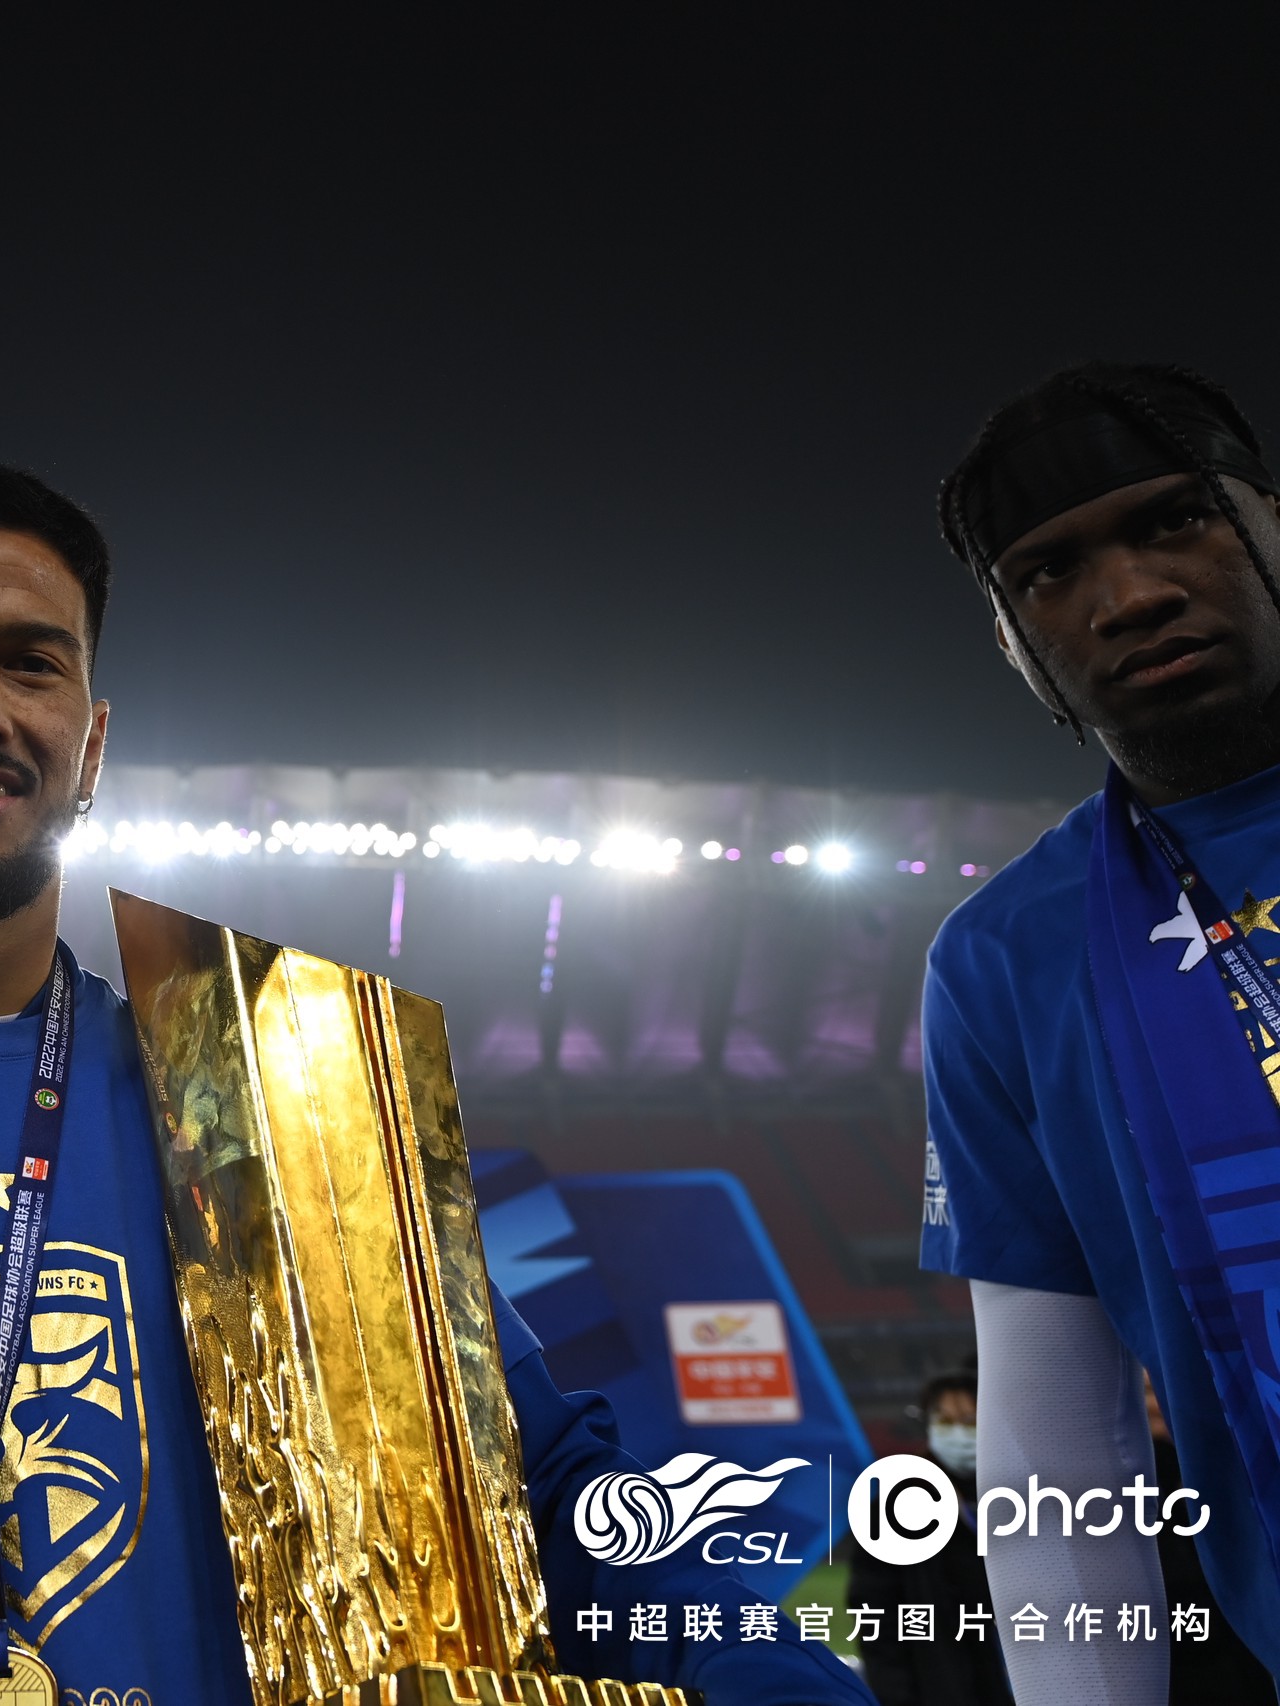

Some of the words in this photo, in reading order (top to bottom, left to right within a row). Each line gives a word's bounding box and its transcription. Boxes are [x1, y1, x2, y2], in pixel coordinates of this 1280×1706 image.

[1235, 943, 1257, 969] LEAGUE
[1253, 967, 1273, 990] SUPER
[62, 1012, 70, 1036] CHINESE
[61, 1036, 67, 1047] AN
[58, 1047, 66, 1064] PING
[33, 1192, 45, 1225] LEAGUE
[28, 1225, 40, 1257] SUPER
[19, 1257, 35, 1321] ASSOCIATION
[68, 1276, 85, 1290] FC
[8, 1322, 23, 1374] FOOTBALL
